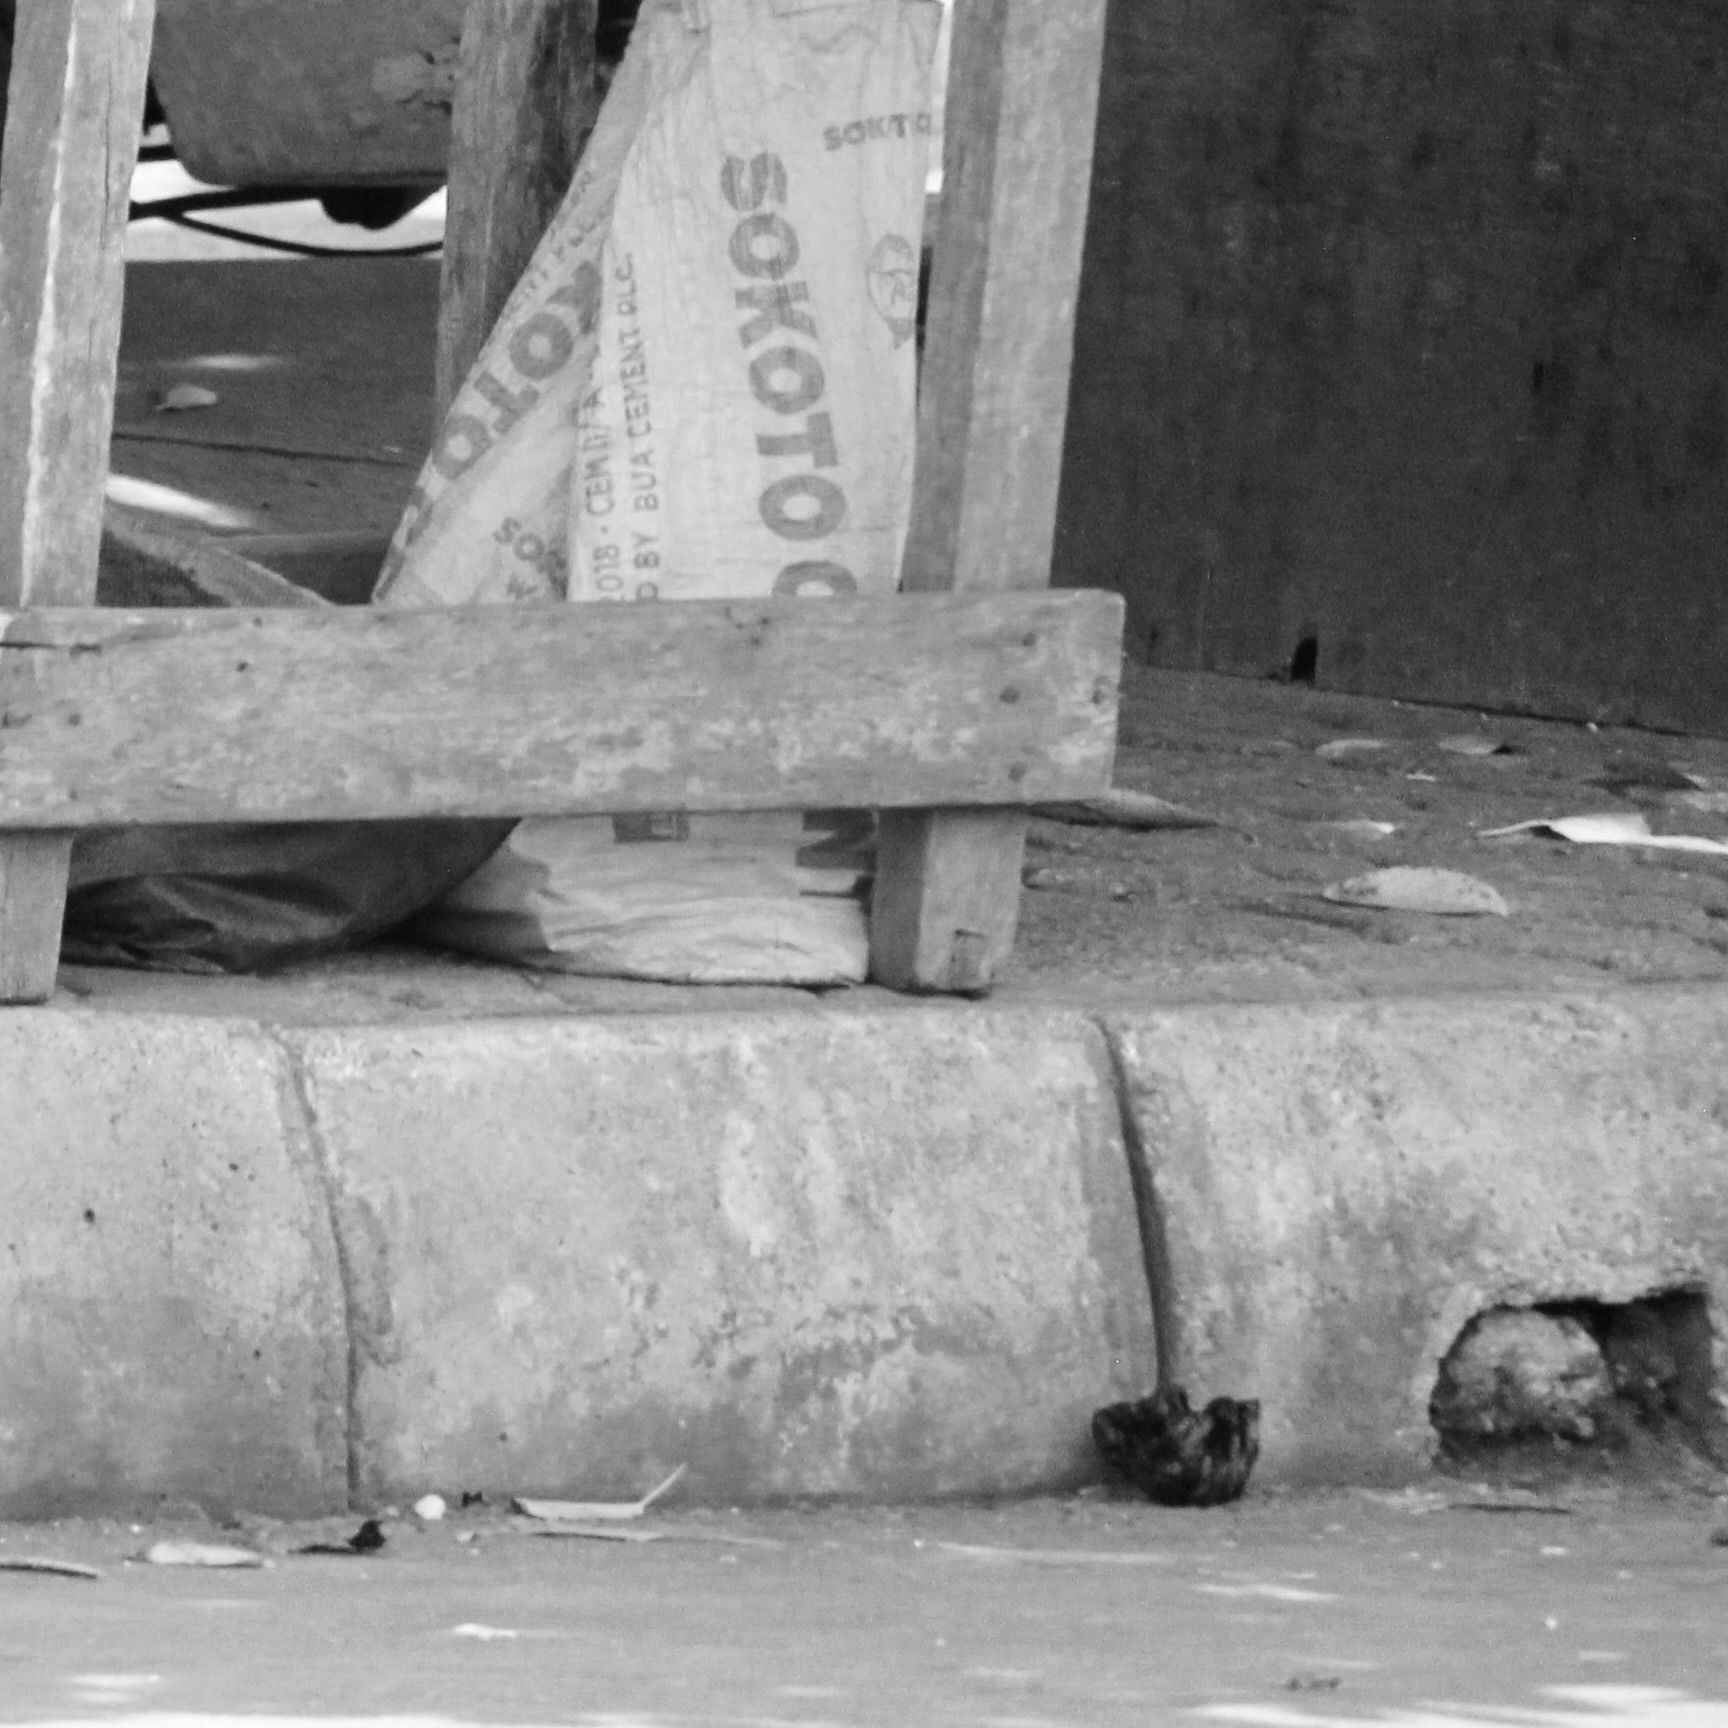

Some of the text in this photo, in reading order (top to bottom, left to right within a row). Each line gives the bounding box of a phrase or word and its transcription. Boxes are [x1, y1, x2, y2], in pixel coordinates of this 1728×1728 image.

[720, 151, 846, 544] SOKOTO
[617, 327, 653, 440] CEMENT
[583, 454, 616, 517] CEM
[629, 449, 660, 513] BUA
[592, 544, 626, 602] 018
[631, 532, 661, 570] BY
